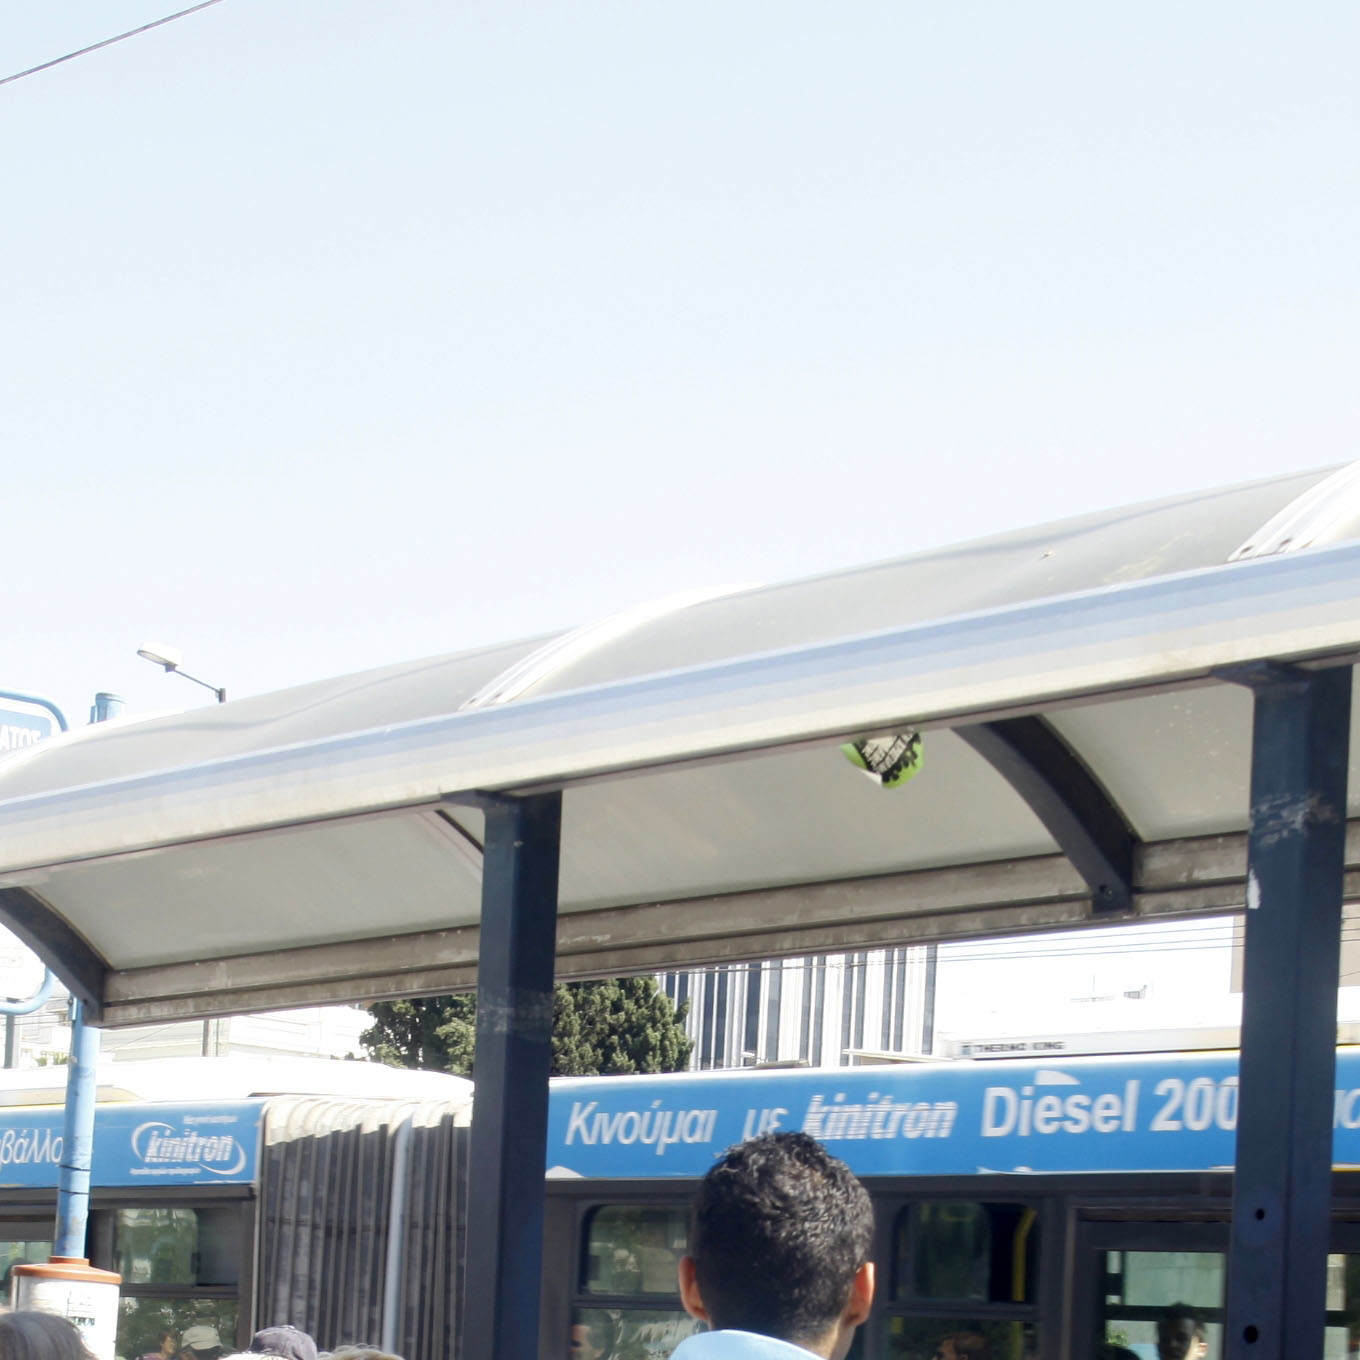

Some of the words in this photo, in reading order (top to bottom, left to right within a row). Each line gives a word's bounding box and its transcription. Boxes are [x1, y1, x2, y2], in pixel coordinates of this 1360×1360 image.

[565, 1100, 718, 1155] Κινούμαι
[801, 1093, 958, 1141] kinitron
[980, 1079, 1140, 1137] Diesel
[1148, 1075, 1239, 1132] 200
[144, 1128, 233, 1163] kinitron
